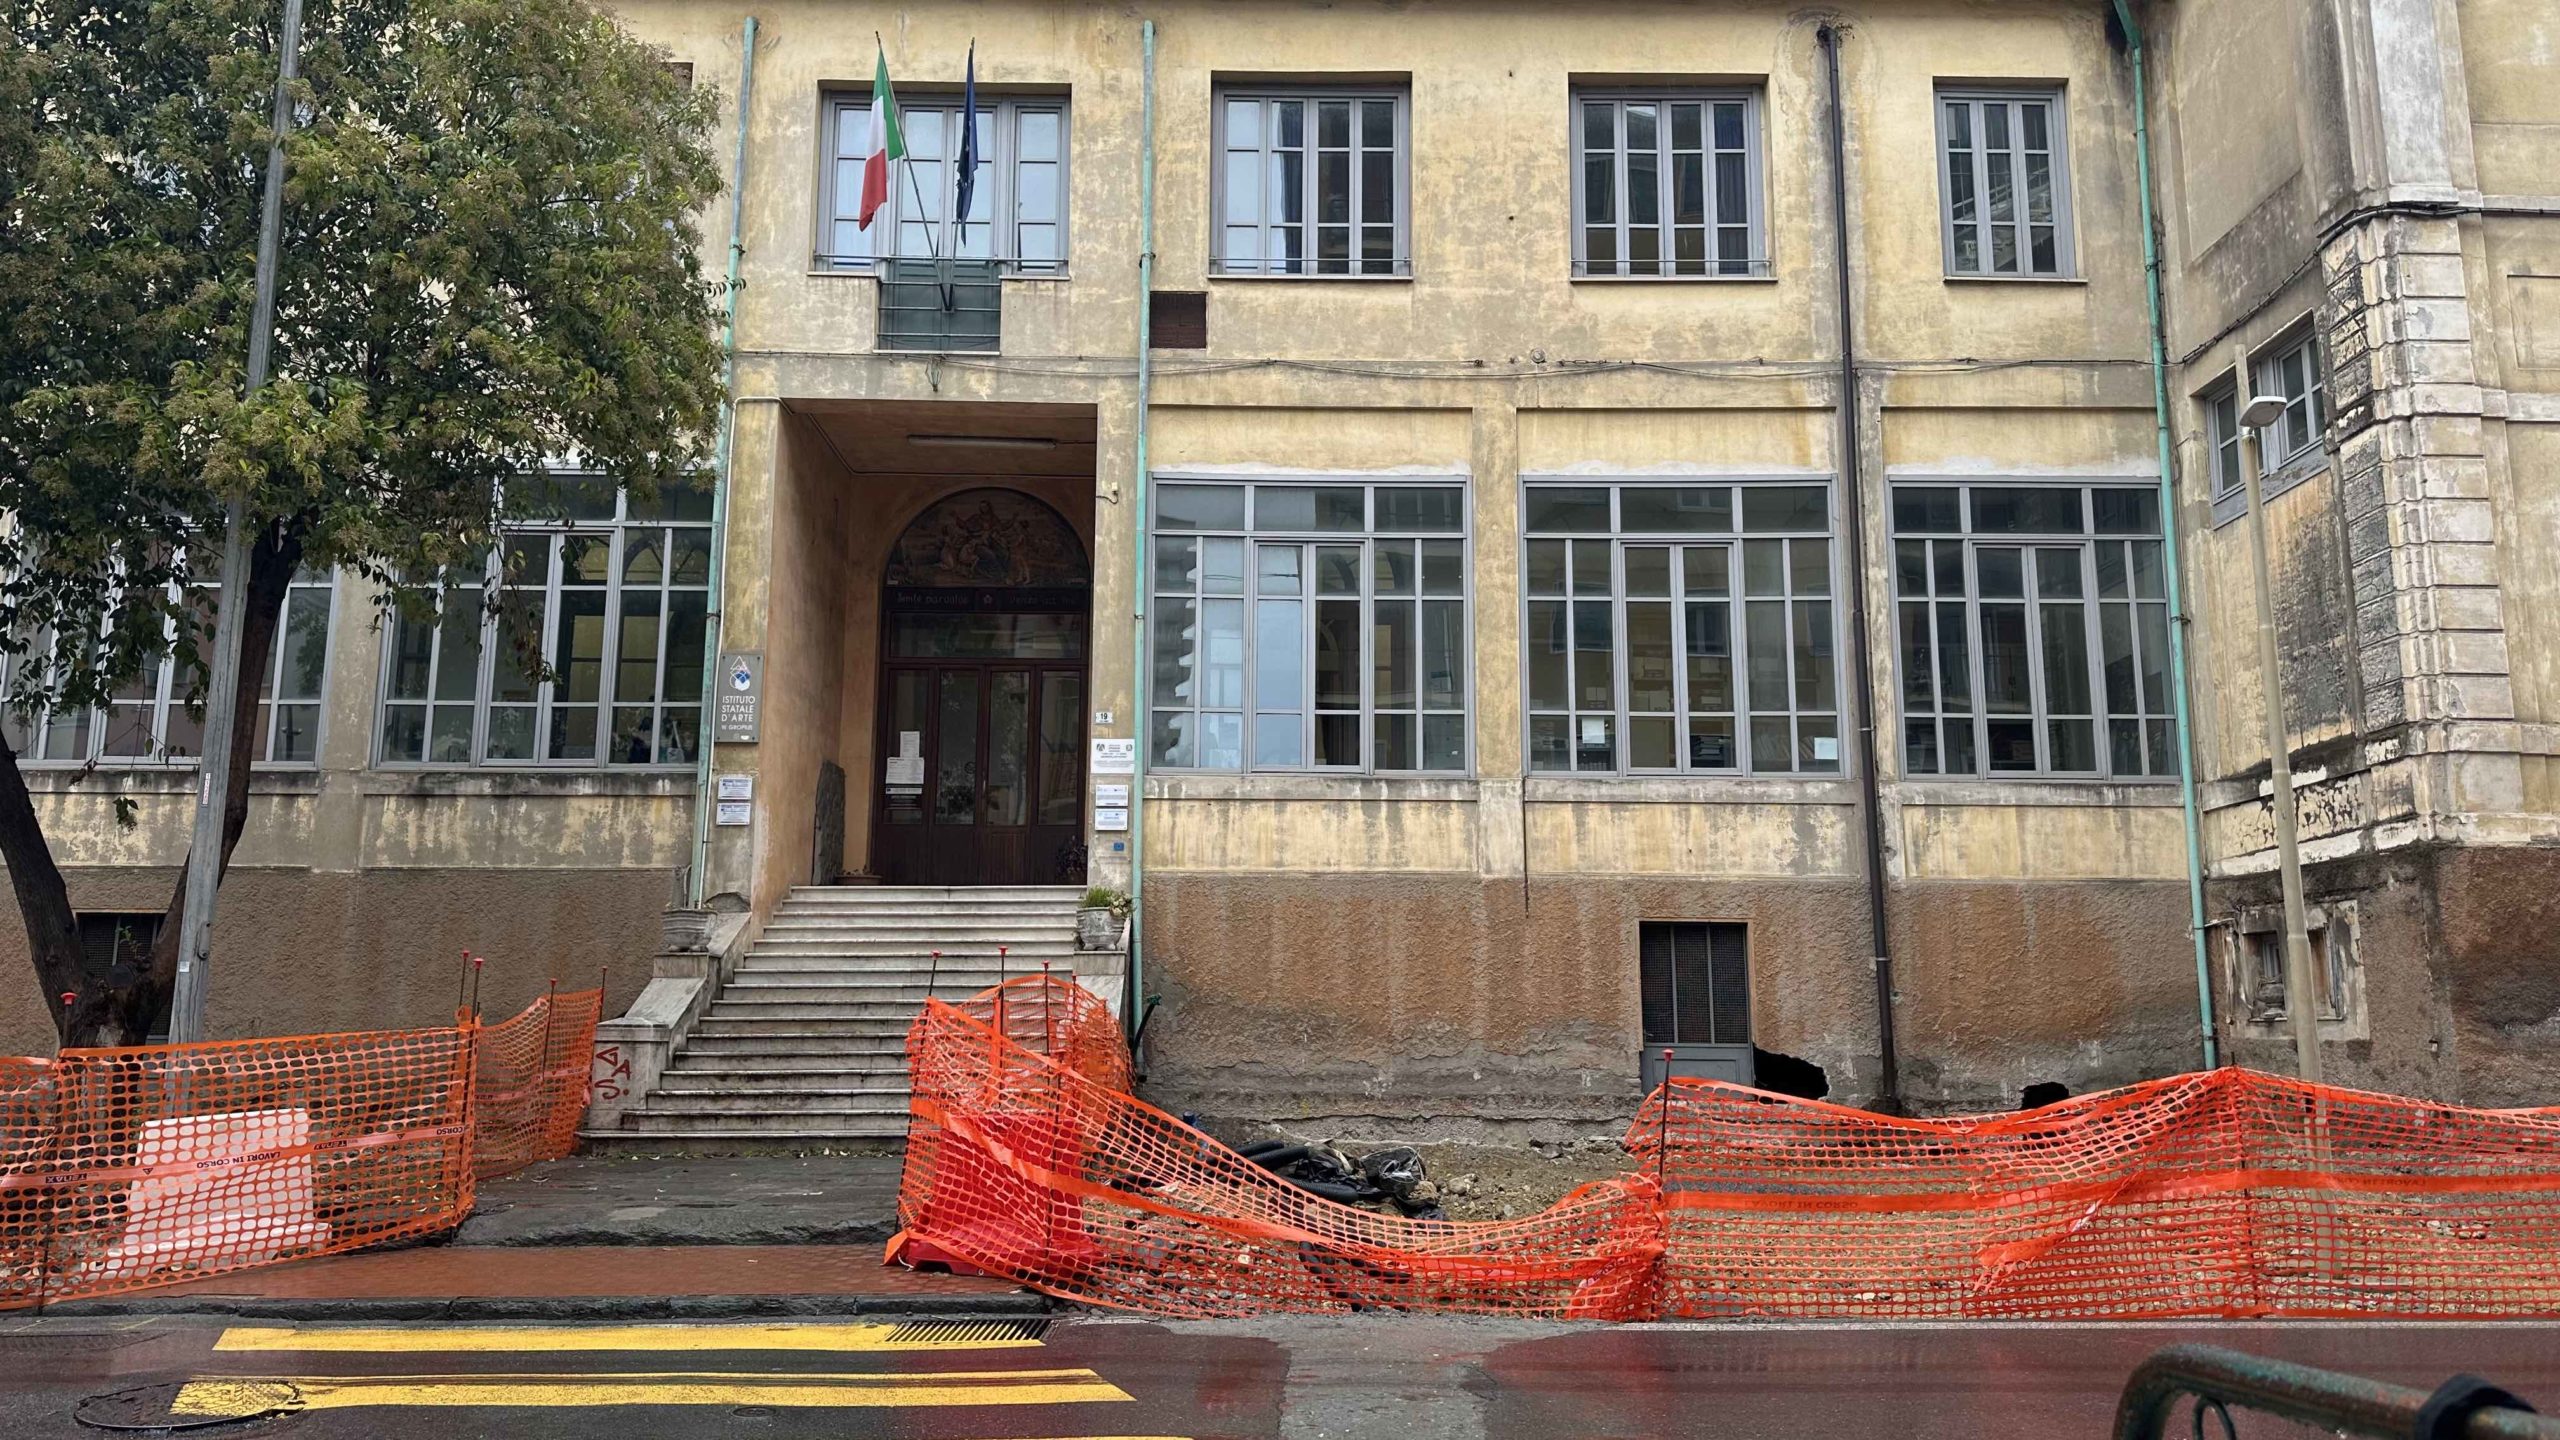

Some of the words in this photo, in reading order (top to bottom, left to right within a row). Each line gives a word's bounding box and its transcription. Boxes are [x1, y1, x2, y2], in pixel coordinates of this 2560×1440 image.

[722, 696, 756, 704] ISTITUTO
[721, 705, 754, 713] STATALE
[721, 714, 754, 722] D'ARTE
[437, 1127, 464, 1135] CORSO
[247, 1151, 281, 1162] LAVORI
[196, 1160, 229, 1169] CORSO
